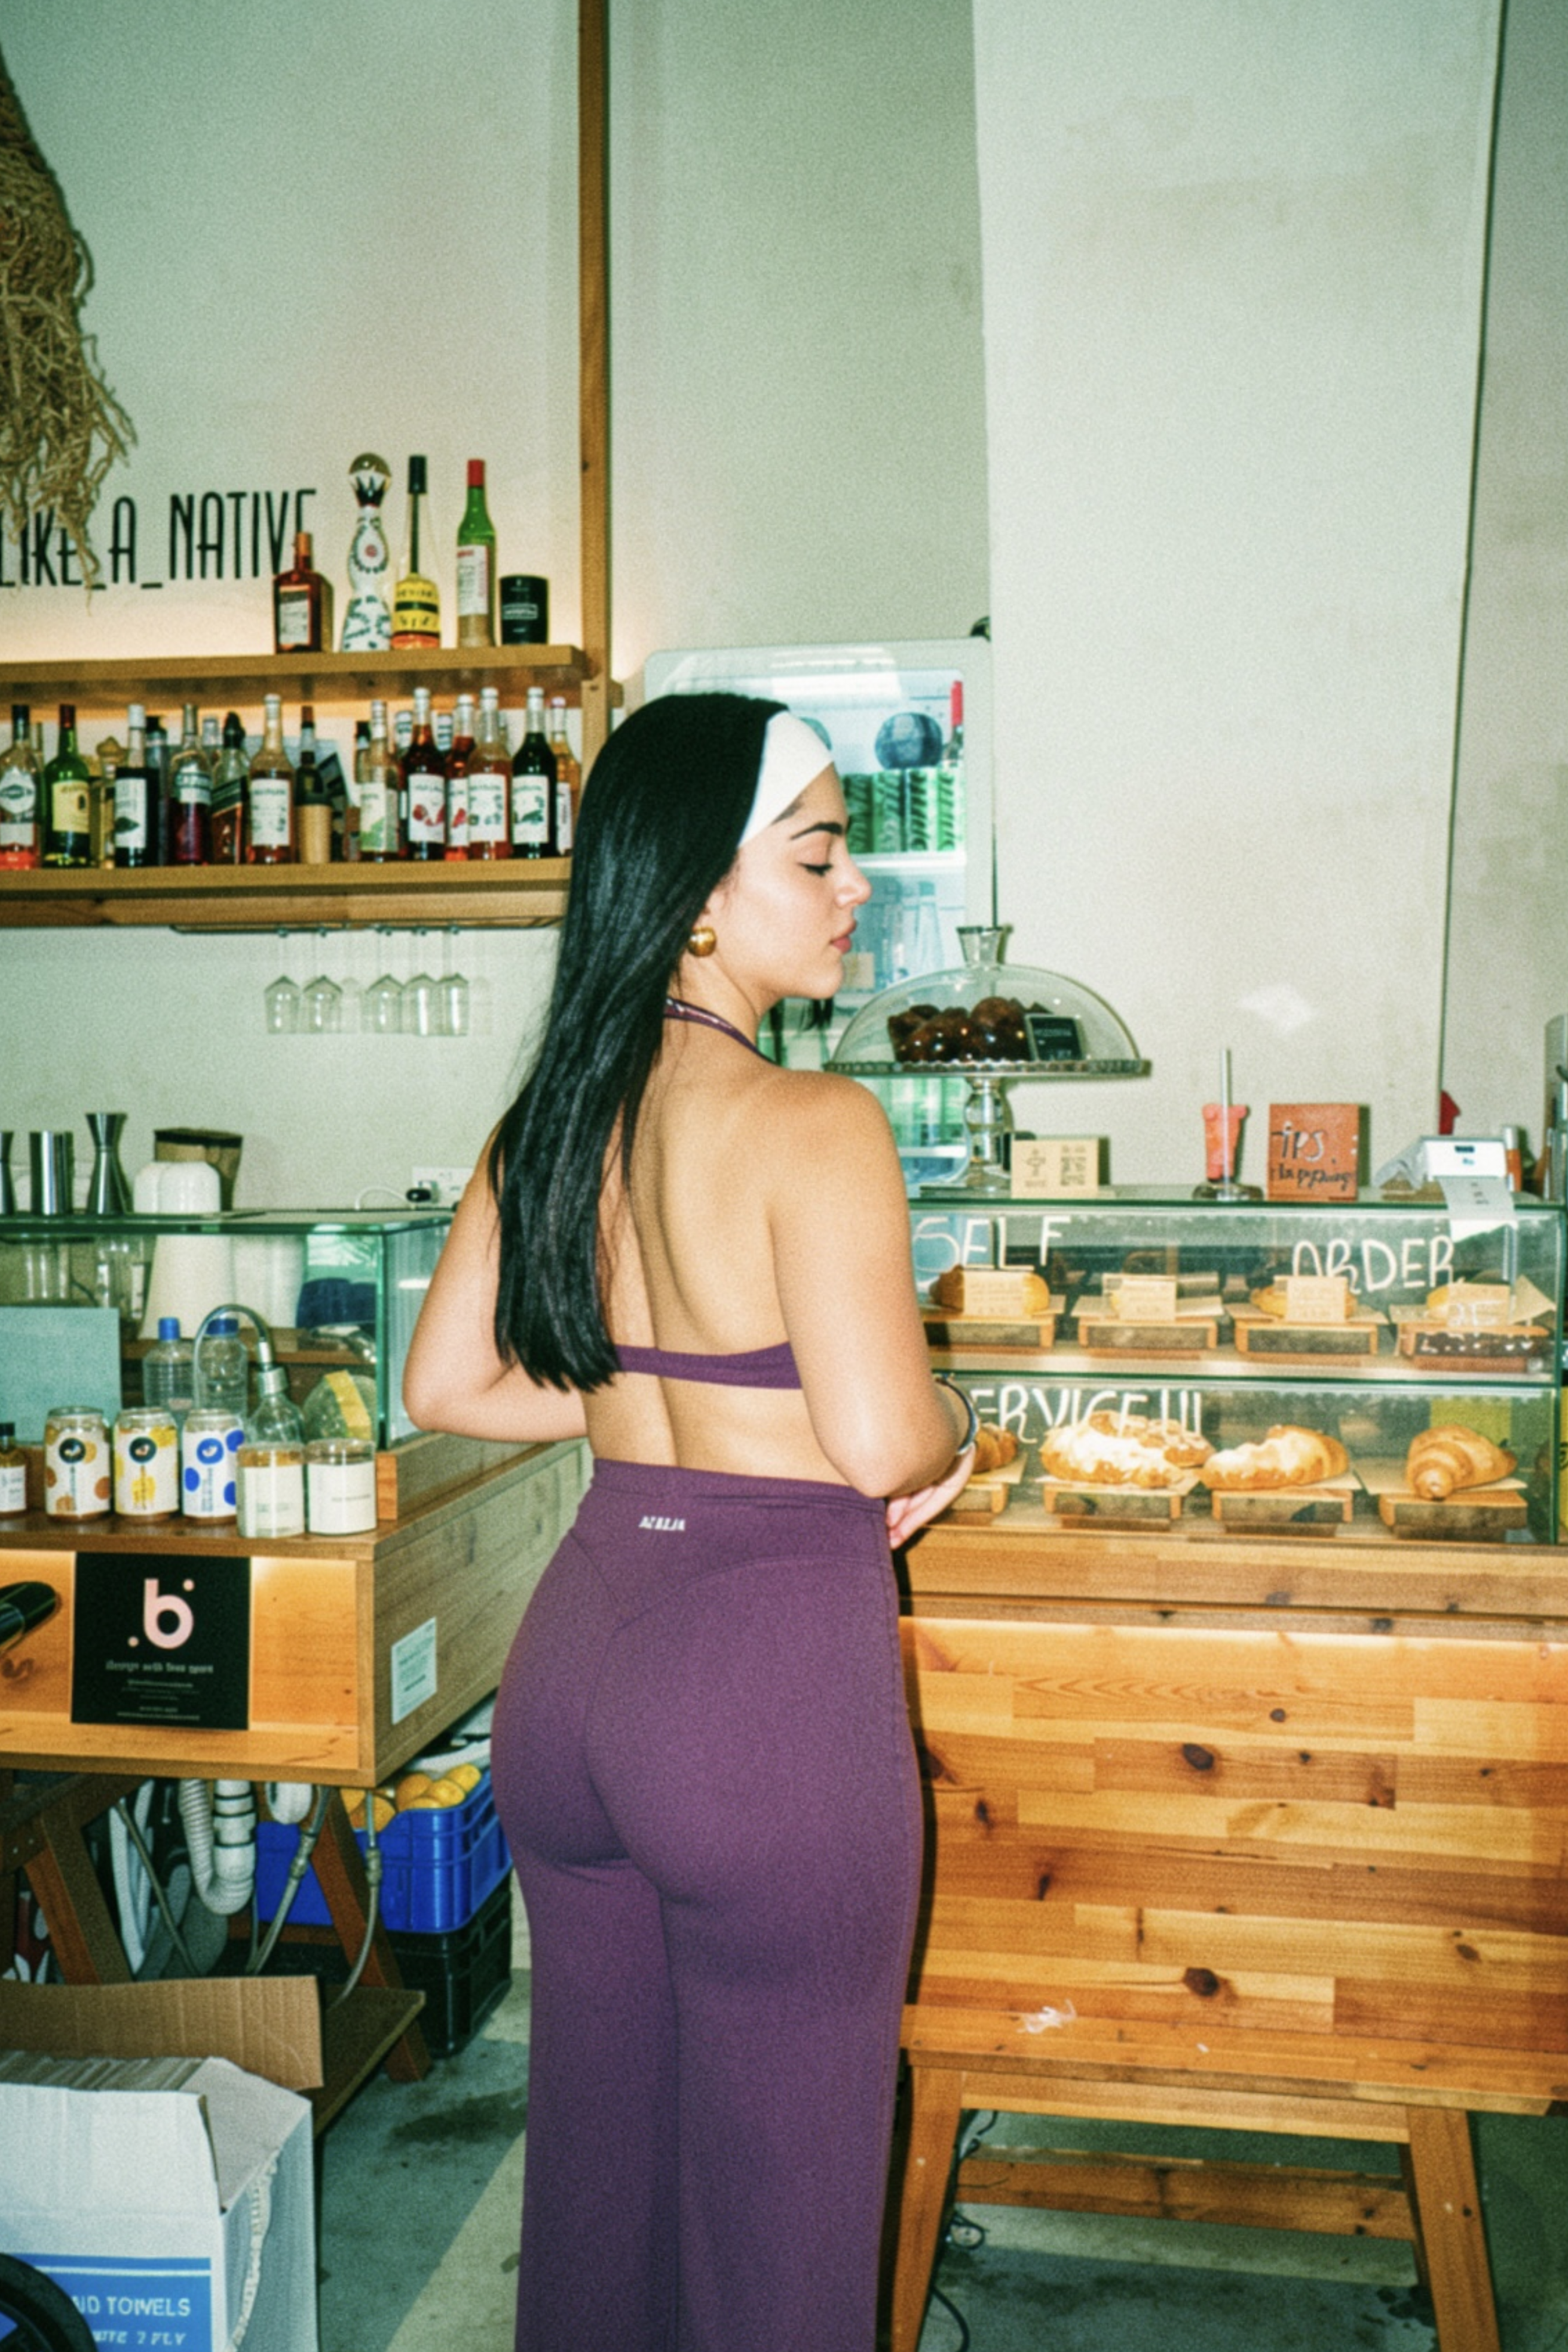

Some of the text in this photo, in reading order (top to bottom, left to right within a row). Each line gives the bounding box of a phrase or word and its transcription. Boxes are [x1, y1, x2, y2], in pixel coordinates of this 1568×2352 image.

[912, 1215, 1071, 1293] SELF
[1292, 1235, 1454, 1294] ORDER
[72, 2295, 191, 2317] ND TOWELS
